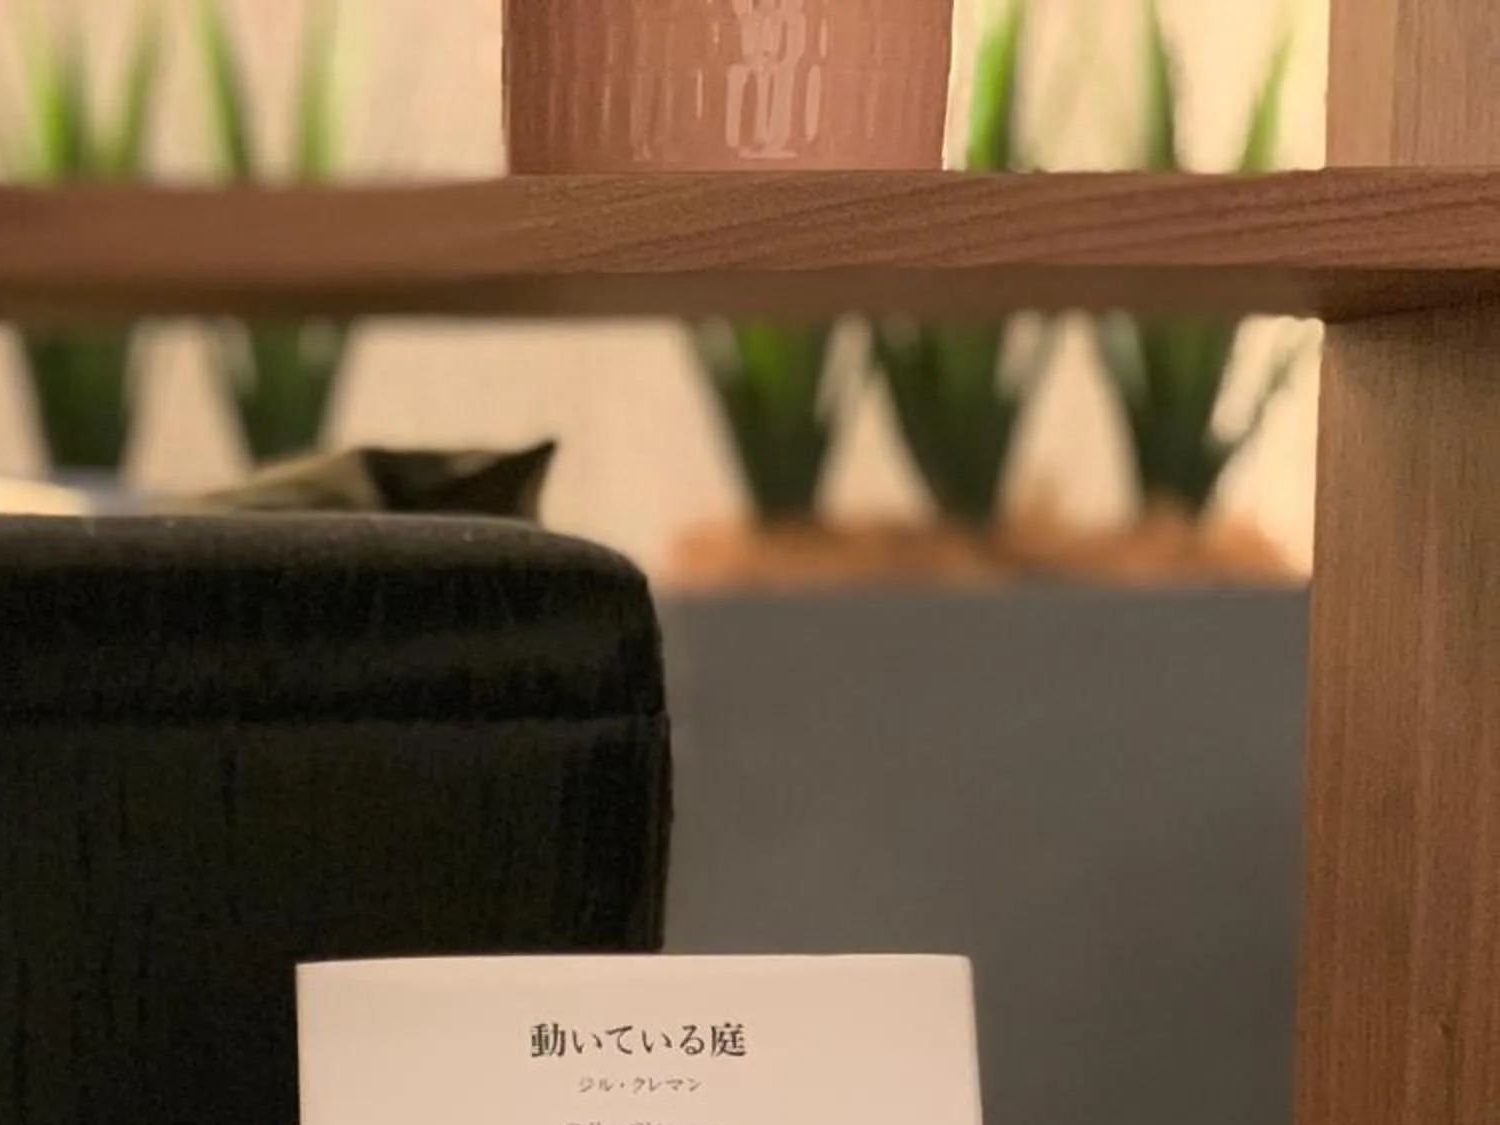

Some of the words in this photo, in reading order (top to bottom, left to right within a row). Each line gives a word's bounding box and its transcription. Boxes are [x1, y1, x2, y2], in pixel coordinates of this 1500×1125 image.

[530, 1022, 748, 1057] 動いている庭
[578, 1076, 702, 1094] ジル・クレマン
